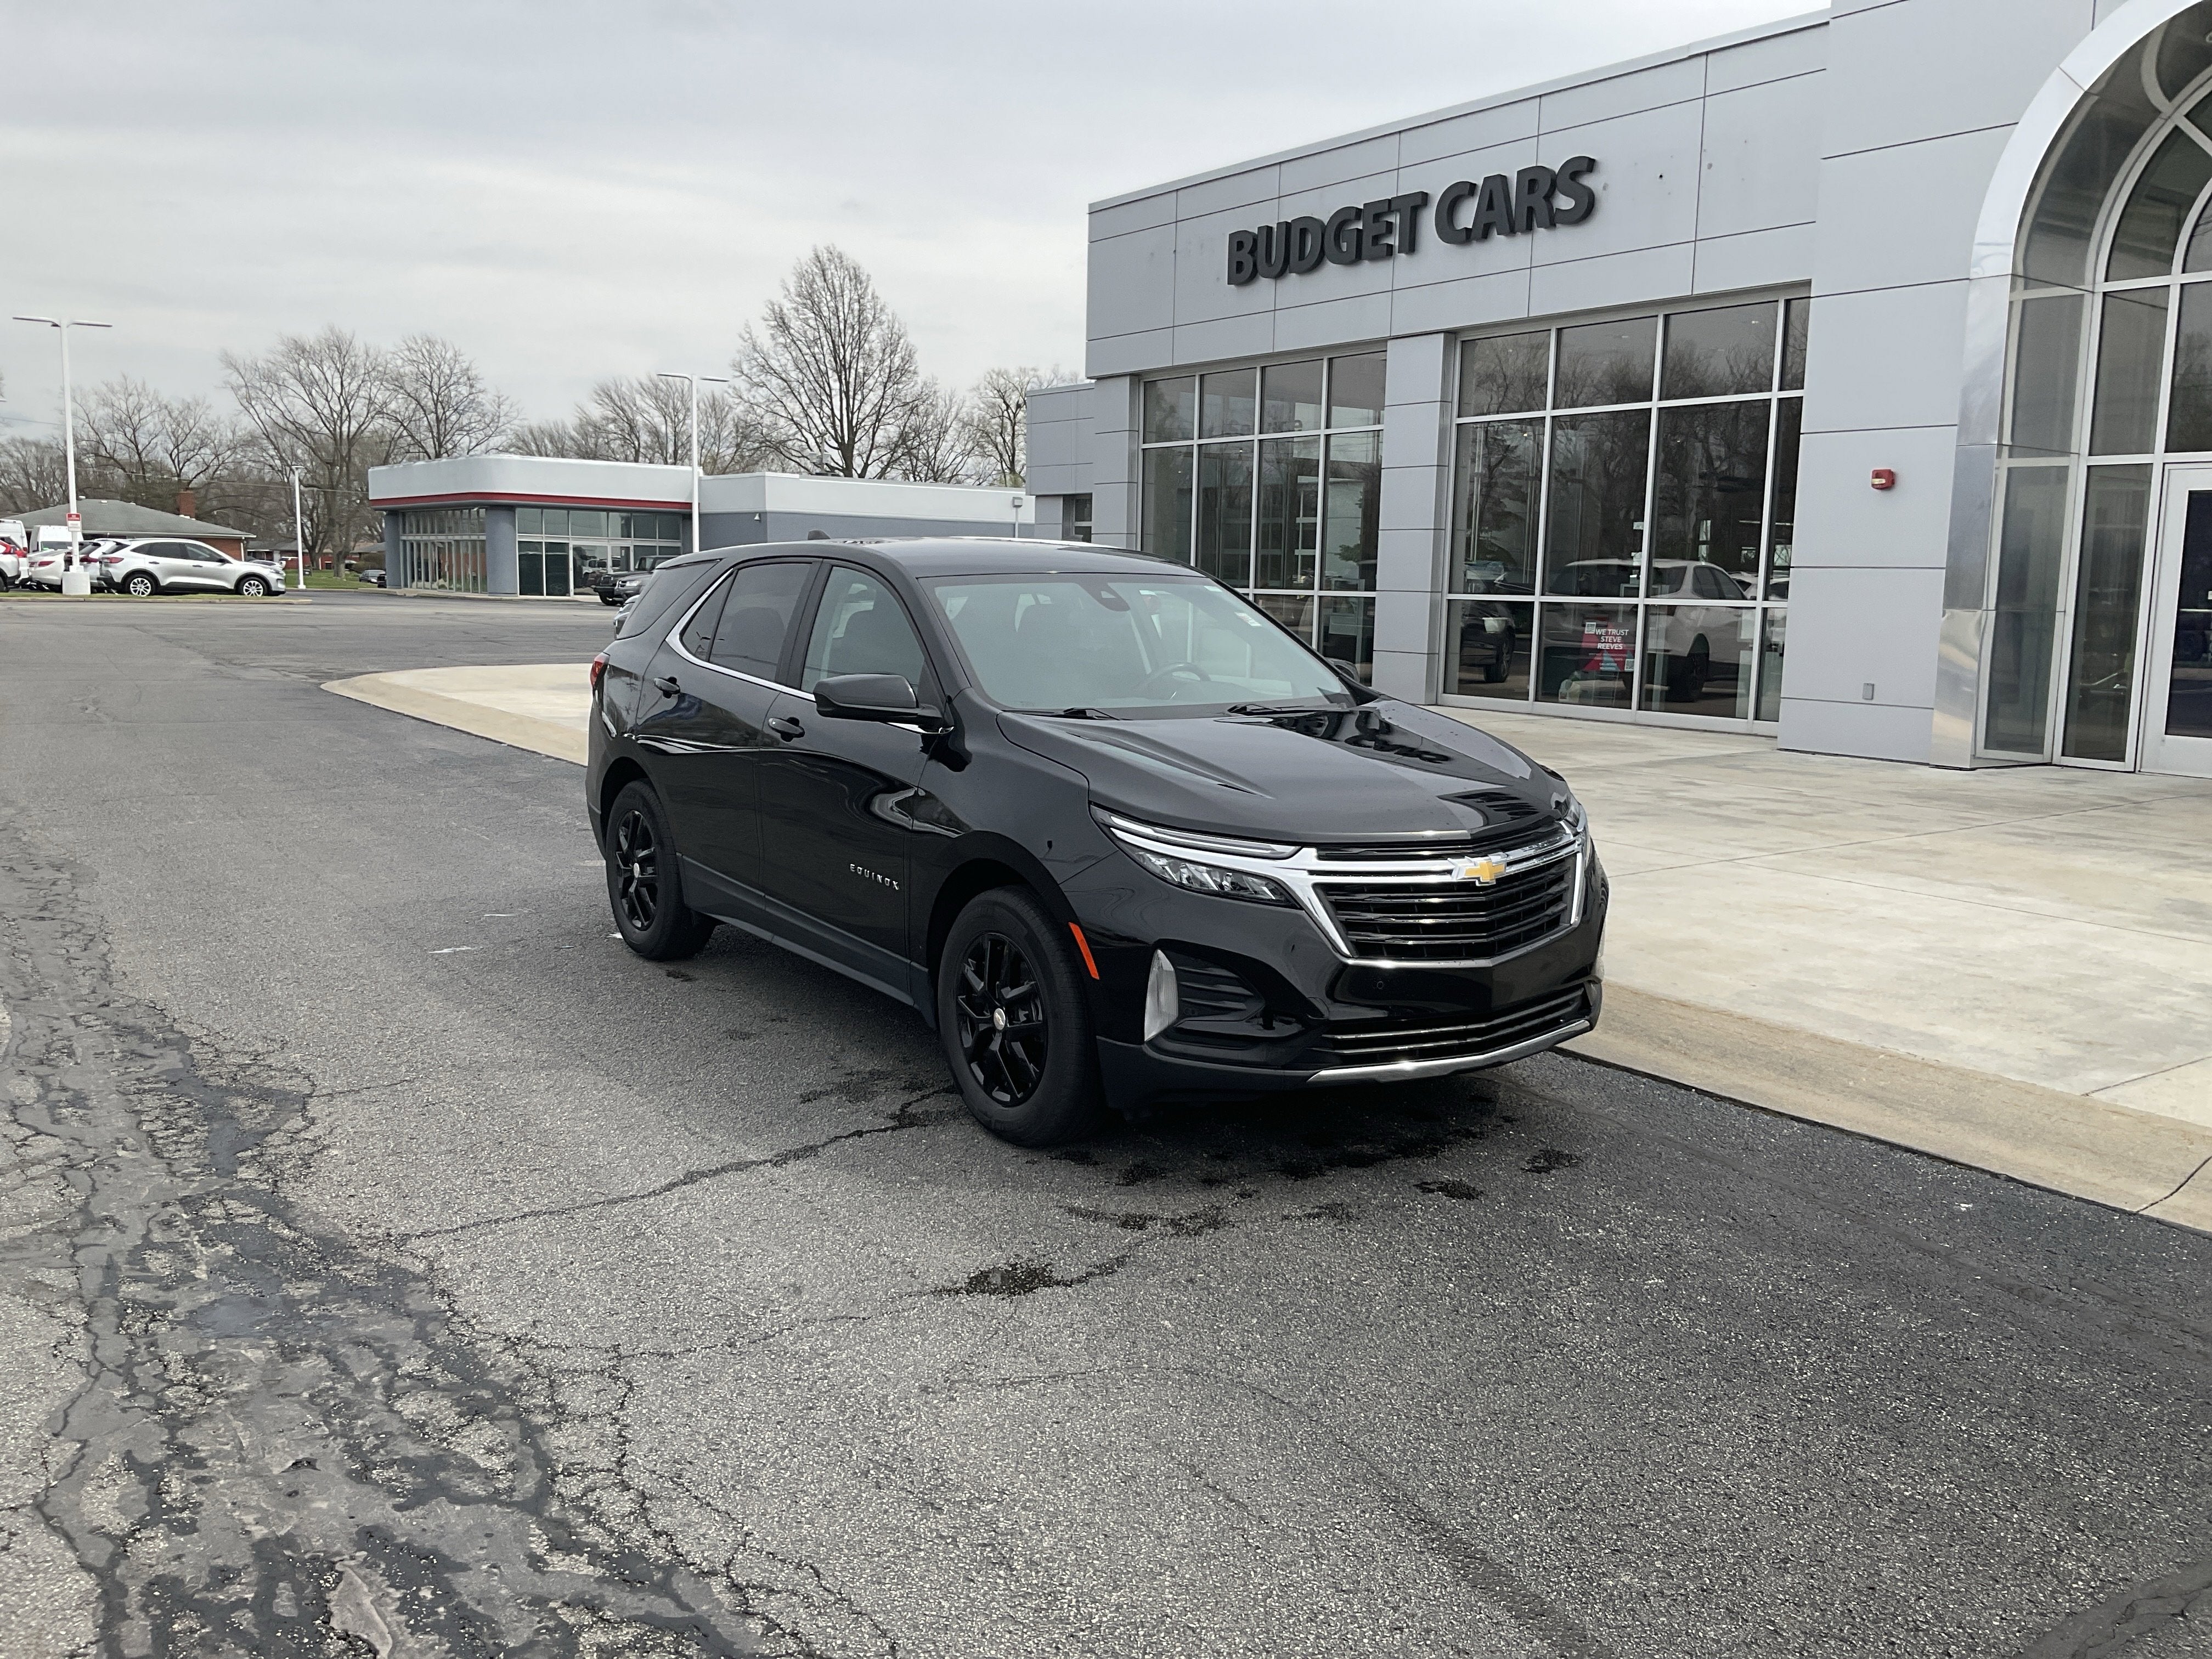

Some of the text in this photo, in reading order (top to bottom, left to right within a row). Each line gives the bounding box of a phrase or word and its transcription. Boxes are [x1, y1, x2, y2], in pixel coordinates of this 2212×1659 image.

[1227, 156, 1596, 285] BUDGET CARS
[850, 863, 900, 890] EQUINOX
